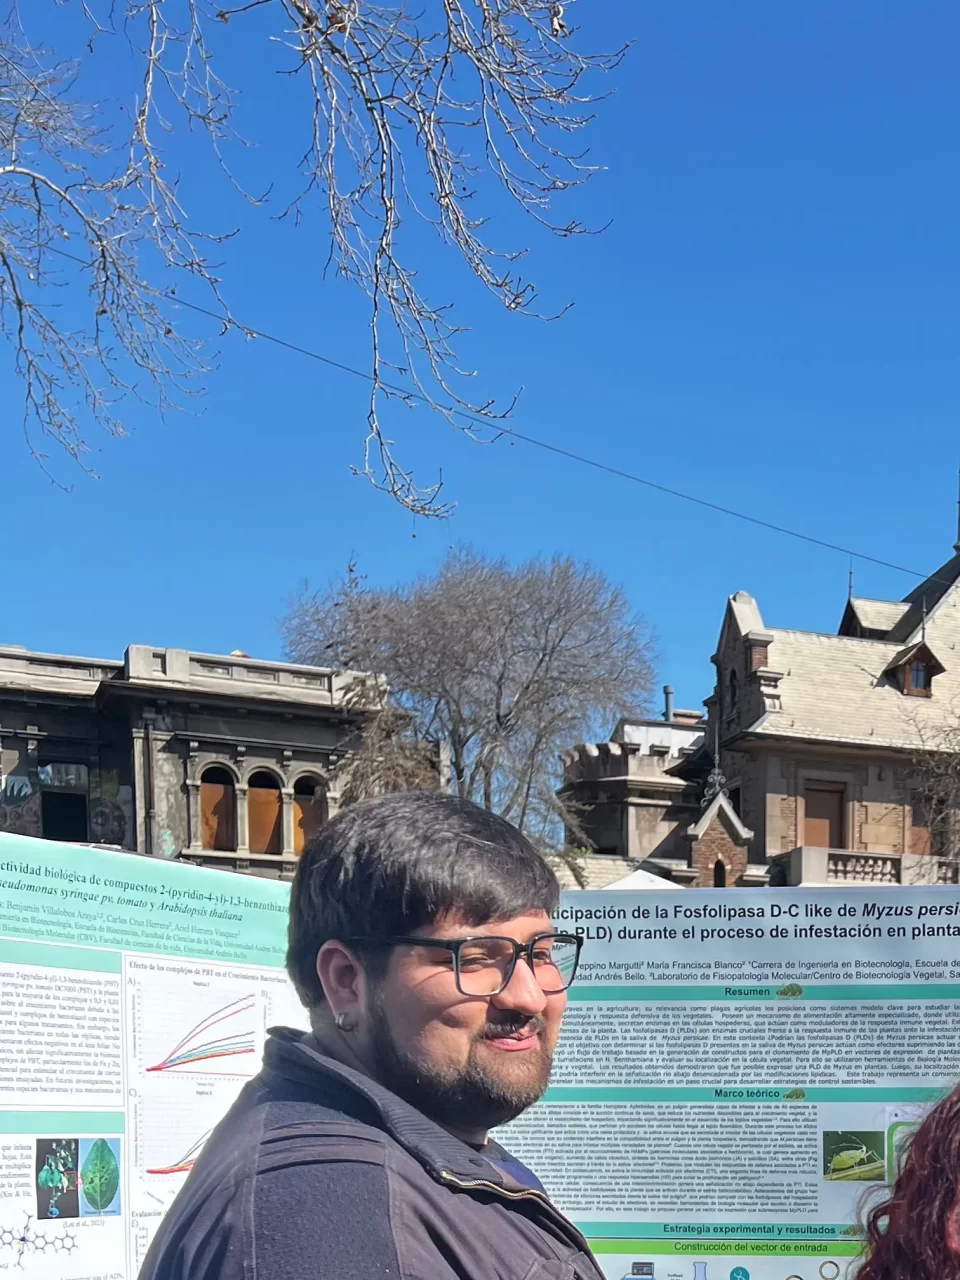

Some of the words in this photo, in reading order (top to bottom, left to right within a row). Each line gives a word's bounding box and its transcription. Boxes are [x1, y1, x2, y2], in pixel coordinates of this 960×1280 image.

[0, 860, 41, 876] ctividad
[45, 866, 86, 884] biológica
[89, 874, 101, 885] de
[104, 879, 157, 894] compuestos
[160, 885, 289, 913] 2-(pyridin-4-yl)-1,3-benzothiazo
[0, 880, 58, 895] seudomonas
[60, 889, 99, 902] syringae
[101, 895, 114, 904] pv.
[117, 897, 147, 908] tomato
[149, 904, 154, 912] y
[158, 902, 207, 917] Arabidopsis
[209, 909, 242, 921] thaliana
[551, 906, 626, 922] ticipación
[632, 906, 650, 918] de
[656, 905, 668, 918] la
[674, 905, 765, 921] Fosfolipasa
[770, 904, 800, 918] D-C
[805, 904, 832, 917] like
[838, 904, 857, 917] de
[862, 903, 913, 920] Myzus
[618, 926, 677, 939] durante
[682, 926, 695, 939] el
[701, 928, 764, 941] proceso
[770, 925, 788, 938] de
[794, 924, 881, 938] infestación
[887, 926, 906, 937] en
[578, 962, 606, 971] eppino
[647, 961, 669, 969] María
[672, 961, 711, 969] Francisca
[798, 960, 838, 970] Ingeniería
[855, 960, 912, 969] Biotecnología,
[916, 960, 948, 968] Escuela
[595, 972, 622, 980] Andrés
[700, 972, 710, 980] de
[713, 972, 768, 981] Fisiopatología
[772, 971, 840, 980] Molecular/Centro
[843, 971, 853, 979] de
[856, 971, 910, 980] Biotecnología
[913, 970, 947, 980] Vegetal,
[725, 988, 770, 996] Resumen
[715, 1090, 743, 1098] Marco
[746, 1089, 780, 1098] teórico
[663, 1225, 710, 1234] Estrategia
[713, 1225, 774, 1234] experimental
[786, 1226, 835, 1234] resultados
[675, 1242, 731, 1250] Construcción
[735, 1243, 748, 1251] del
[750, 1243, 777, 1251] vector
[780, 1243, 792, 1251] de
[794, 1244, 827, 1252] entrada
